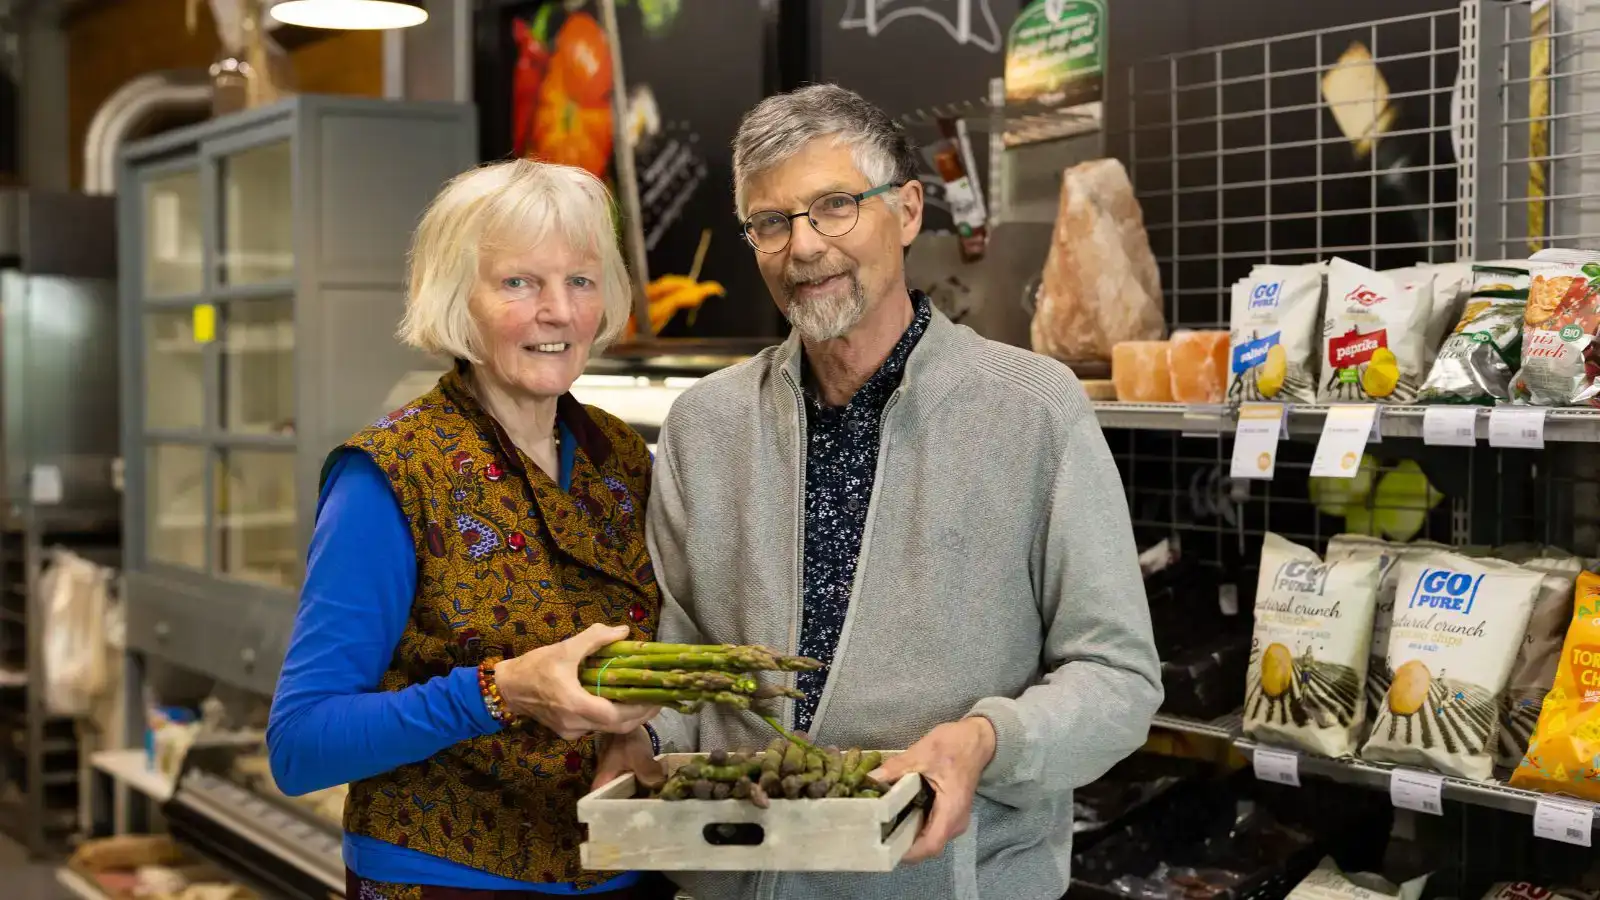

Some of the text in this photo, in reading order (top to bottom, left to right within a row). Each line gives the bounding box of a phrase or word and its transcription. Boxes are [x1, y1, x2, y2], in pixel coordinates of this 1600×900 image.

[1254, 283, 1279, 299] GO
[1473, 333, 1489, 342] BIO
[1562, 328, 1580, 338] BIO
[1241, 343, 1269, 363] salted
[1336, 339, 1378, 361] paprika
[1423, 570, 1473, 596] GO
[1295, 601, 1342, 618] crunch
[1417, 595, 1464, 611] PURE
[1434, 620, 1486, 637] crunch
